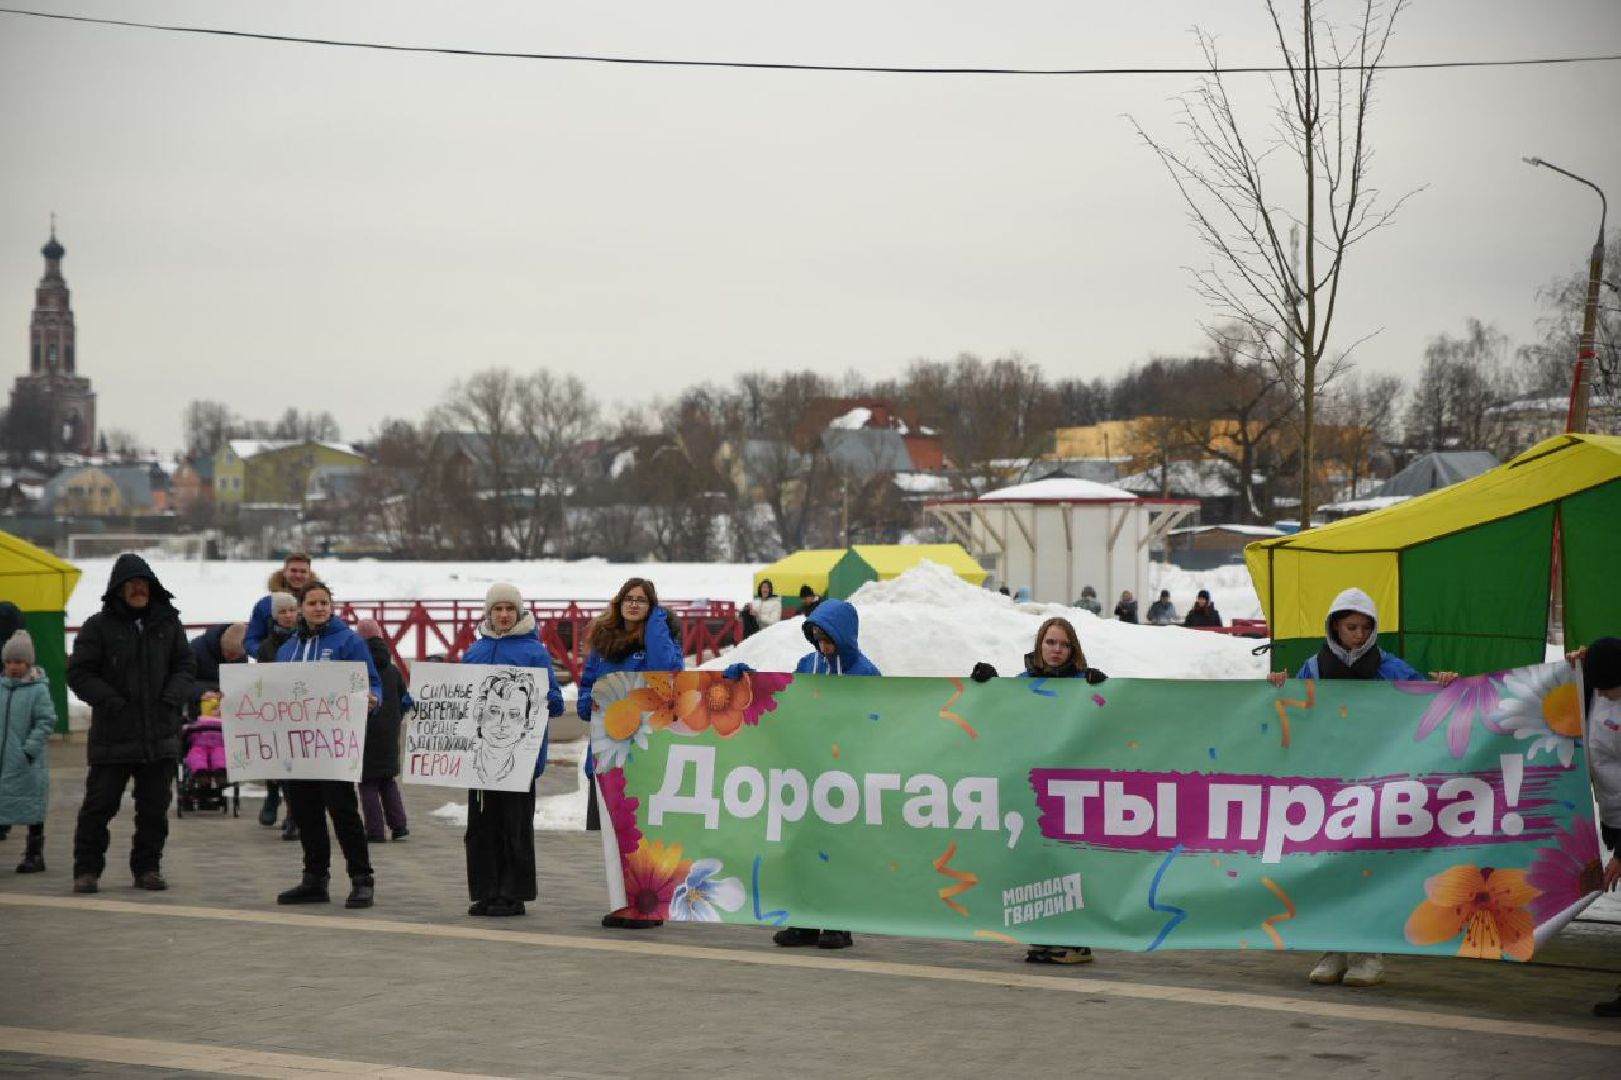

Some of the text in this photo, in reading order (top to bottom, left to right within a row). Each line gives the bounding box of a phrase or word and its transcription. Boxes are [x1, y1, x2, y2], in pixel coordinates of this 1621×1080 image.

[420, 682, 473, 700] СИЛЬНЫЕ
[235, 694, 350, 722] ДОРОГАЯ
[235, 728, 360, 760] ТЫ ПРАВА
[411, 753, 461, 777] ГЕРОИ
[648, 743, 1525, 864] Дорогая, ты права!
